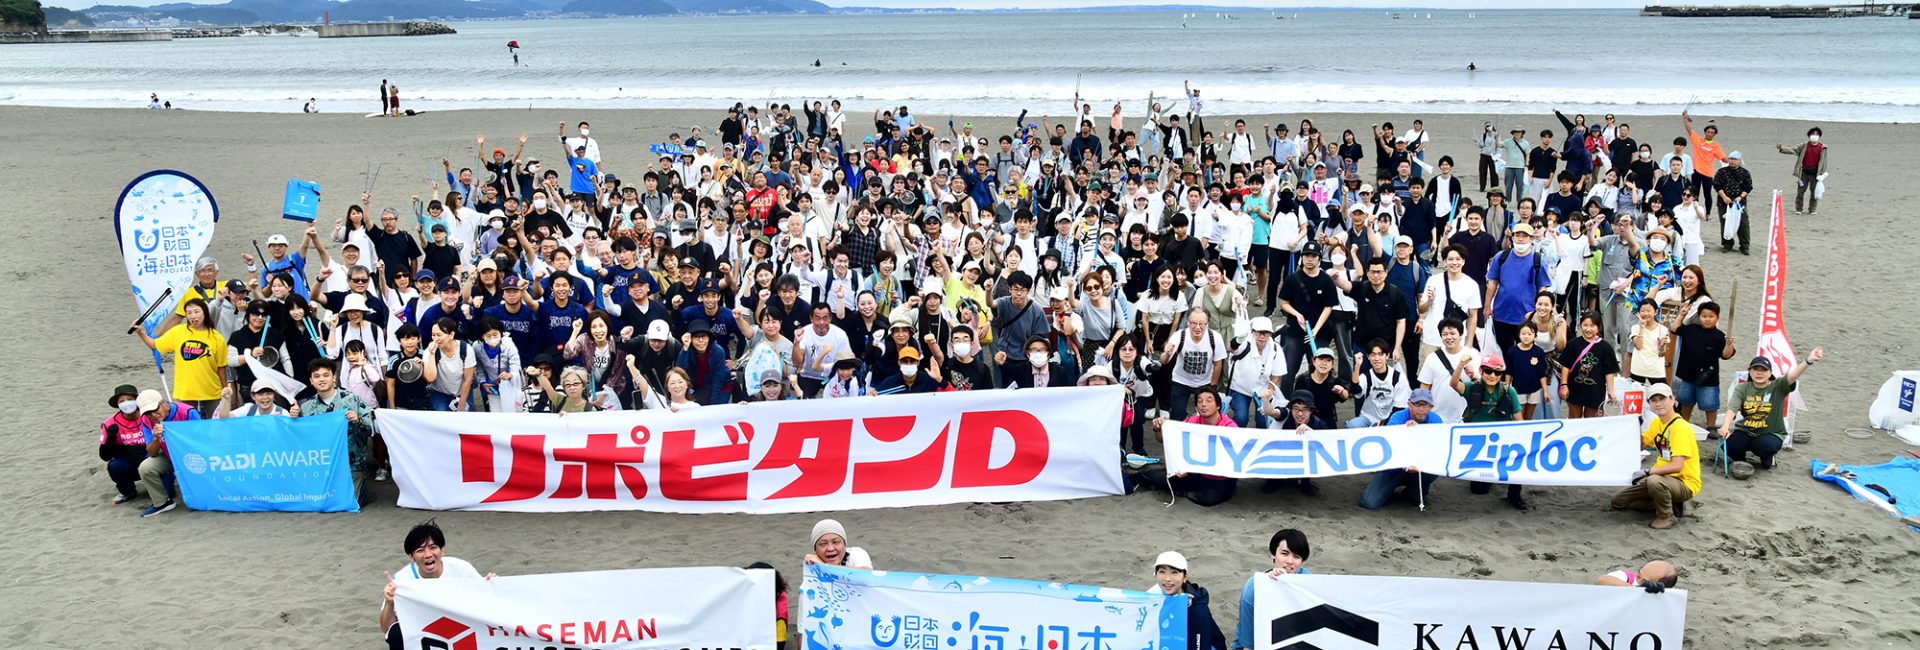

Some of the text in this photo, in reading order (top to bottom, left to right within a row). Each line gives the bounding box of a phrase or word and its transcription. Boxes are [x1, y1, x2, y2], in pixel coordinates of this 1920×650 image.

[162, 226, 189, 238] 日本
[137, 254, 192, 276] 海と日本
[160, 266, 193, 274] PROJECT
[208, 449, 332, 471] PADI AWARE
[458, 408, 1050, 503] リポビタンD
[1181, 431, 1393, 475] UYENO
[1459, 431, 1598, 481] Ziploc
[274, 493, 303, 501] Global
[485, 618, 657, 645] HASEMAN
[904, 615, 939, 631] 日本
[904, 633, 938, 650] 財団
[1413, 623, 1662, 650] KAWANO
